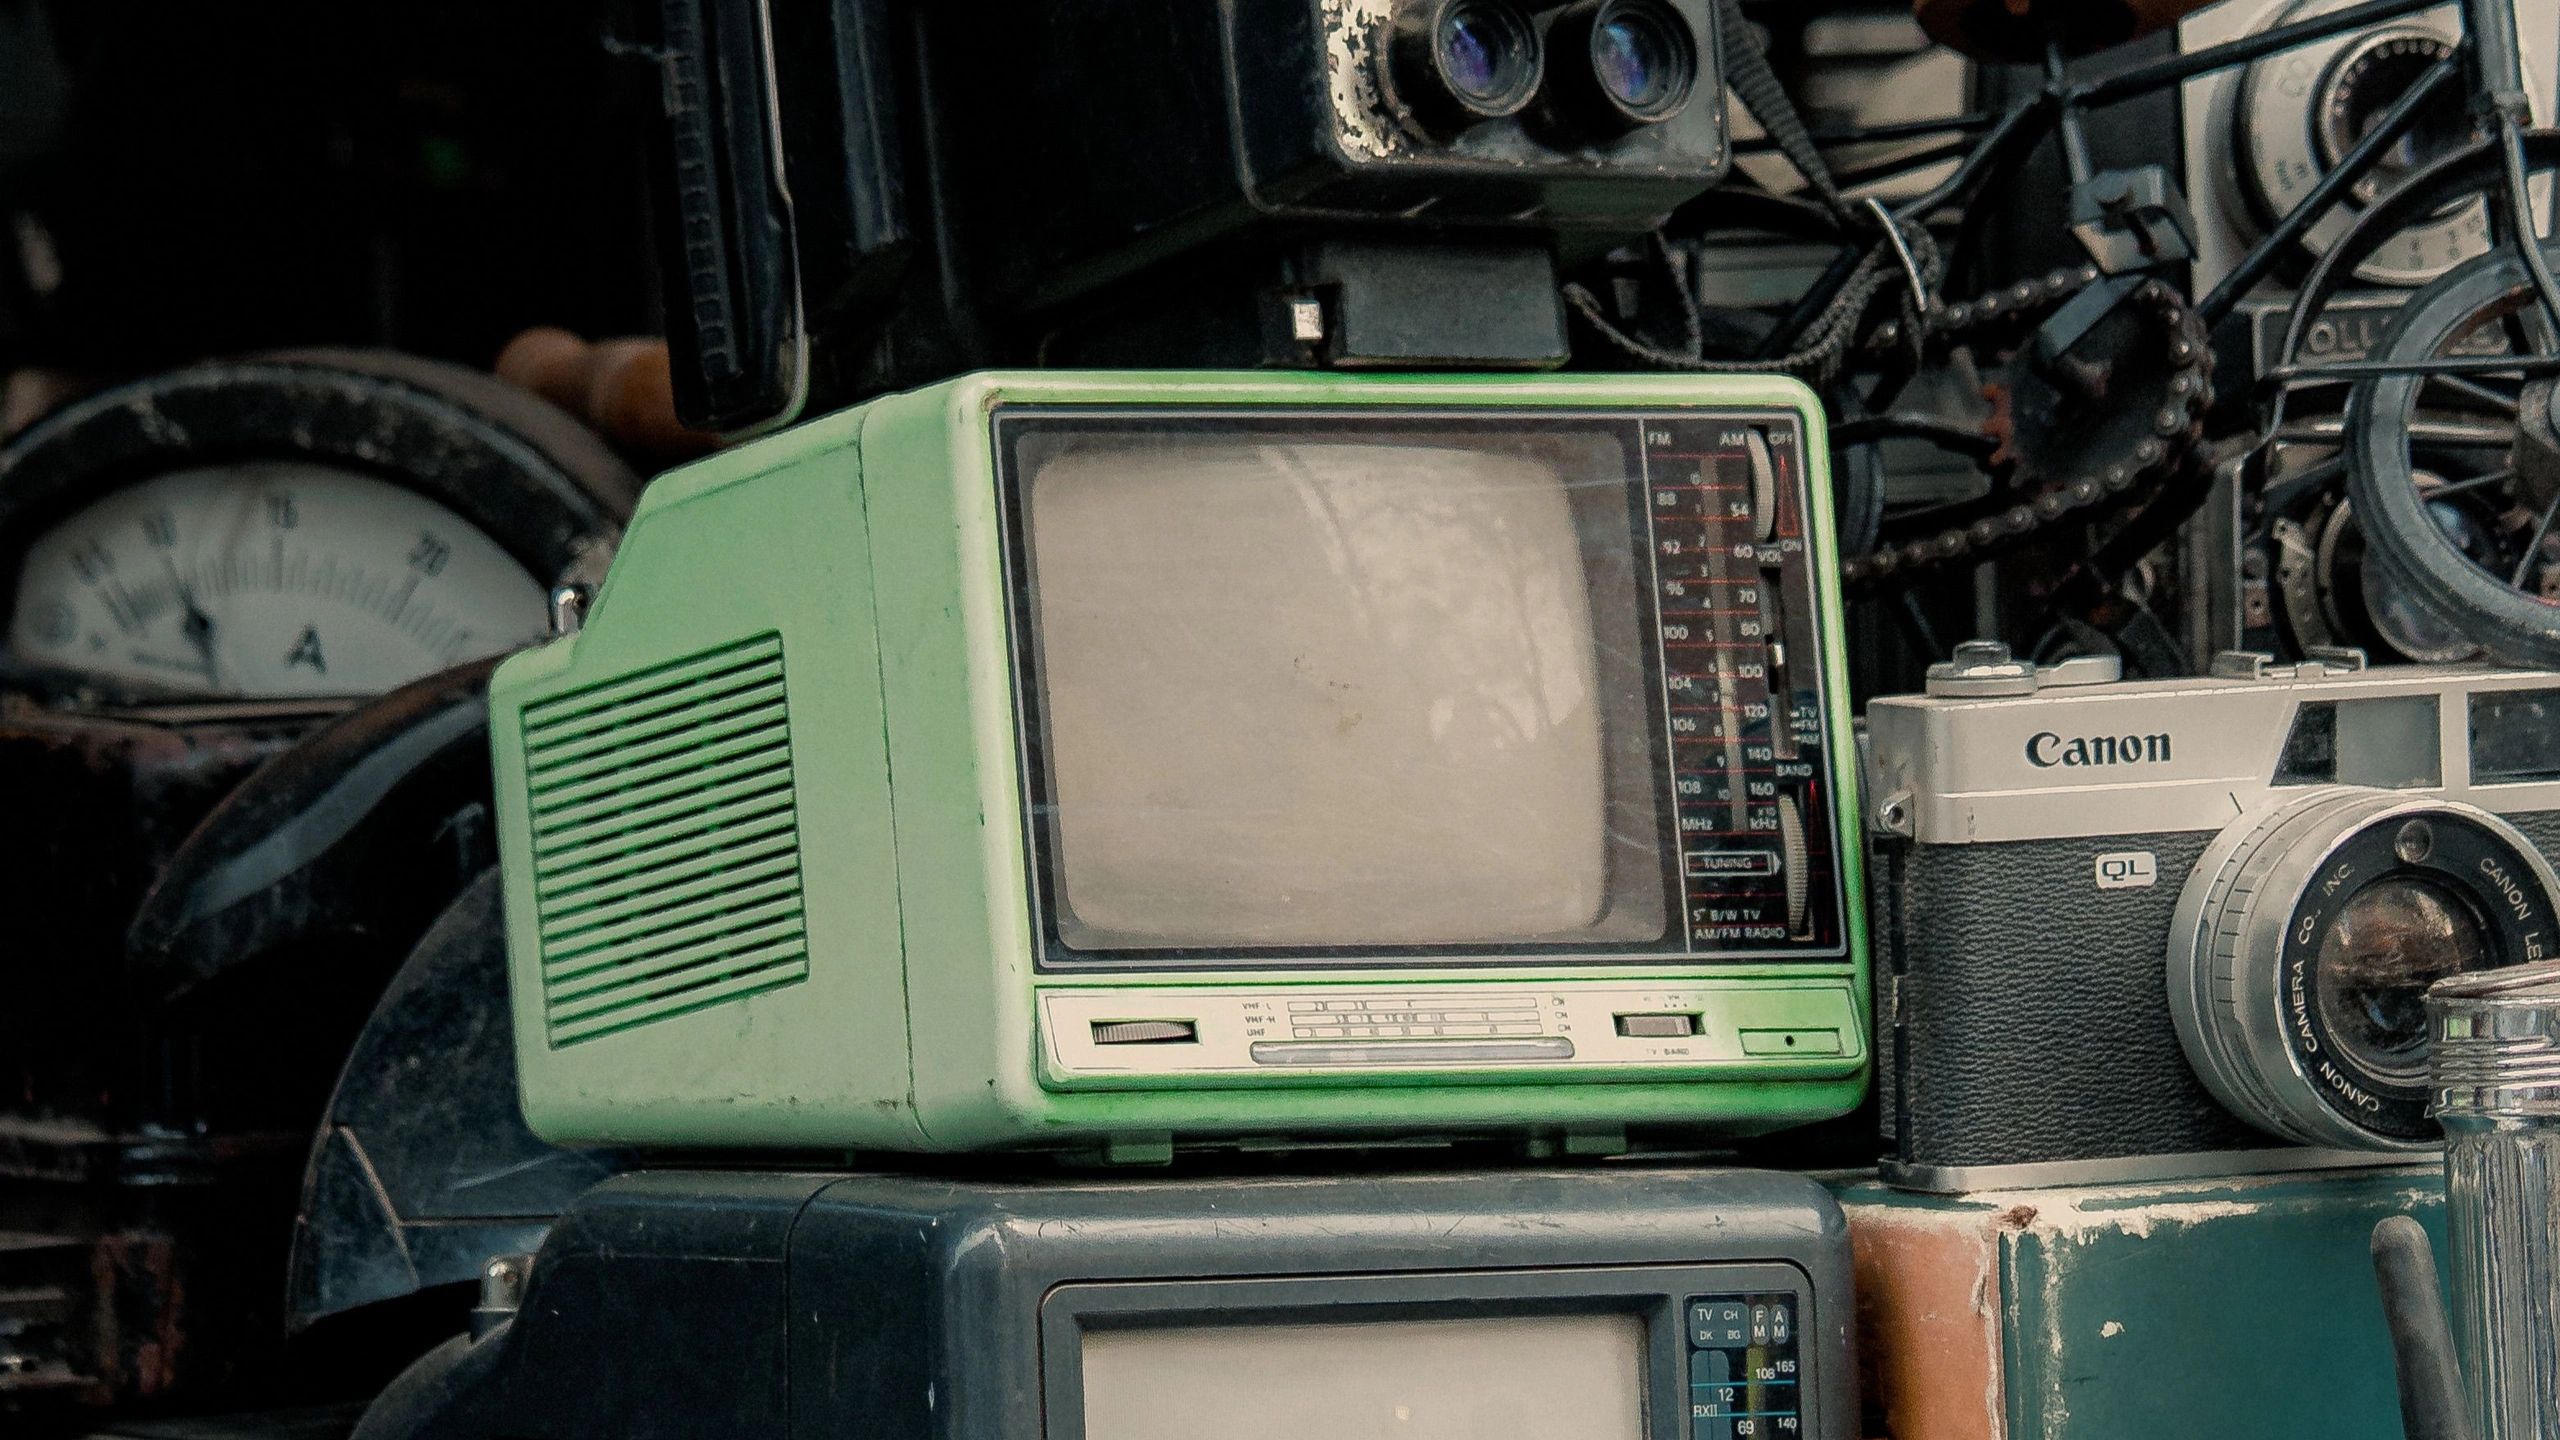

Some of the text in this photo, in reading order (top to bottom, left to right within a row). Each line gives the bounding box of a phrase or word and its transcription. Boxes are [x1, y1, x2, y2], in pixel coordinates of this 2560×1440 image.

[1648, 431, 1672, 446] FM
[1719, 431, 1745, 446] AM
[1730, 502, 1749, 516] 54
[1663, 539, 1681, 555] 92
[1733, 544, 1753, 558] 60
[1665, 582, 1685, 596] 96
[1739, 589, 1757, 604] 70
[1664, 625, 1689, 640] 100
[1741, 622, 1760, 636] 80
[286, 625, 327, 674] A
[1739, 664, 1763, 679] 100
[1668, 676, 1692, 690] 104
[1744, 704, 1767, 718] 120
[1672, 717, 1696, 732] 106
[1747, 748, 1772, 761] 140
[2024, 731, 2172, 769] Canon
[1775, 764, 1813, 777] BAND
[1677, 781, 1702, 795] 108
[1751, 781, 1775, 796] 160
[1681, 818, 1713, 831] MHz
[1703, 857, 1752, 870] TUNING
[2101, 859, 2150, 880] QL
[2480, 857, 2532, 921] CANON
[1709, 909, 1738, 922] B/W
[1743, 909, 1761, 921] TV
[1694, 928, 1786, 941] AM/FM RADIO
[2291, 960, 2318, 1053] CAMERA
[2320, 1061, 2380, 1113] CANON
[1698, 1309, 1738, 1321] TV CH
[1700, 1330, 1741, 1340] DK BG
[1755, 1368, 1776, 1379] 108
[1775, 1361, 1796, 1372] 165
[1718, 1388, 1734, 1401] 12
[1737, 1420, 1755, 1435] 69
[1777, 1417, 1797, 1429] 140
